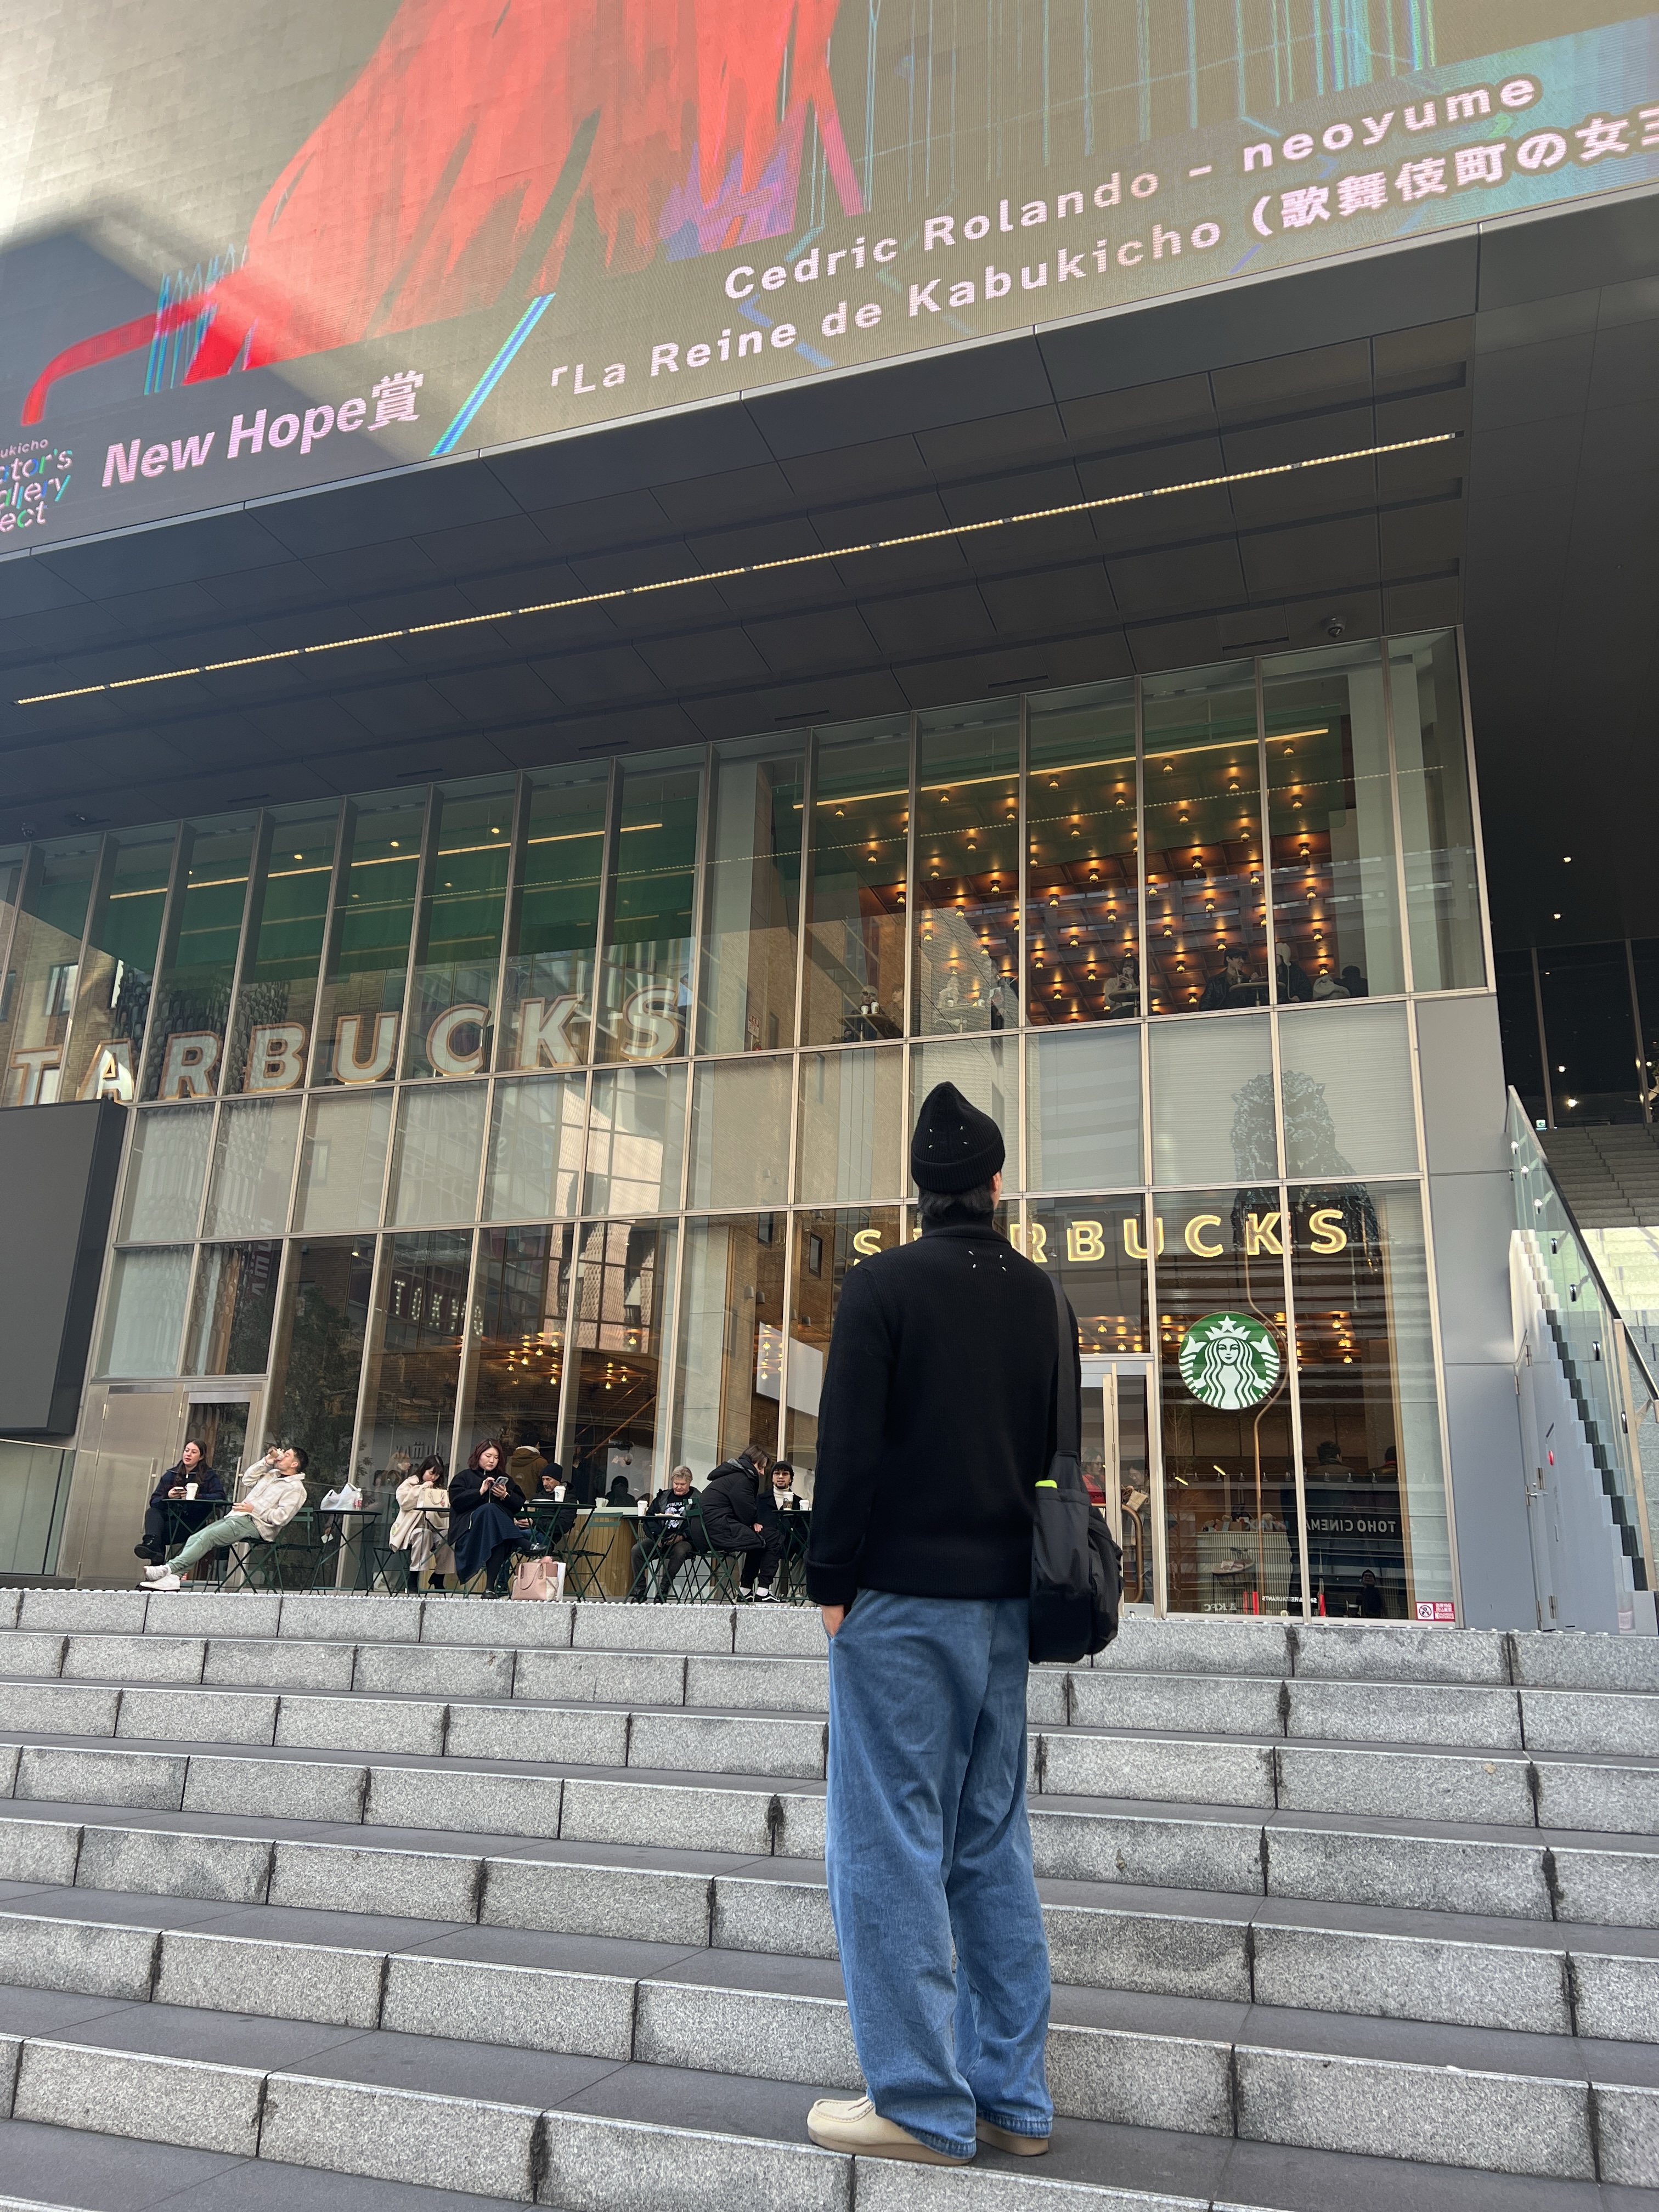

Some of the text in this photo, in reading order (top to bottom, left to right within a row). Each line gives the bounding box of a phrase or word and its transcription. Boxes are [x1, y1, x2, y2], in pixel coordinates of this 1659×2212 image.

[724, 236, 898, 299] Cedric
[924, 171, 1159, 252] Rolando
[1243, 78, 1536, 171] neoyume
[651, 322, 797, 377] Reine
[821, 301, 882, 337] de
[909, 222, 1221, 317] Kabukicho
[101, 370, 424, 488] New Hope賞
[853, 1209, 1347, 1266] SRBUCKS
